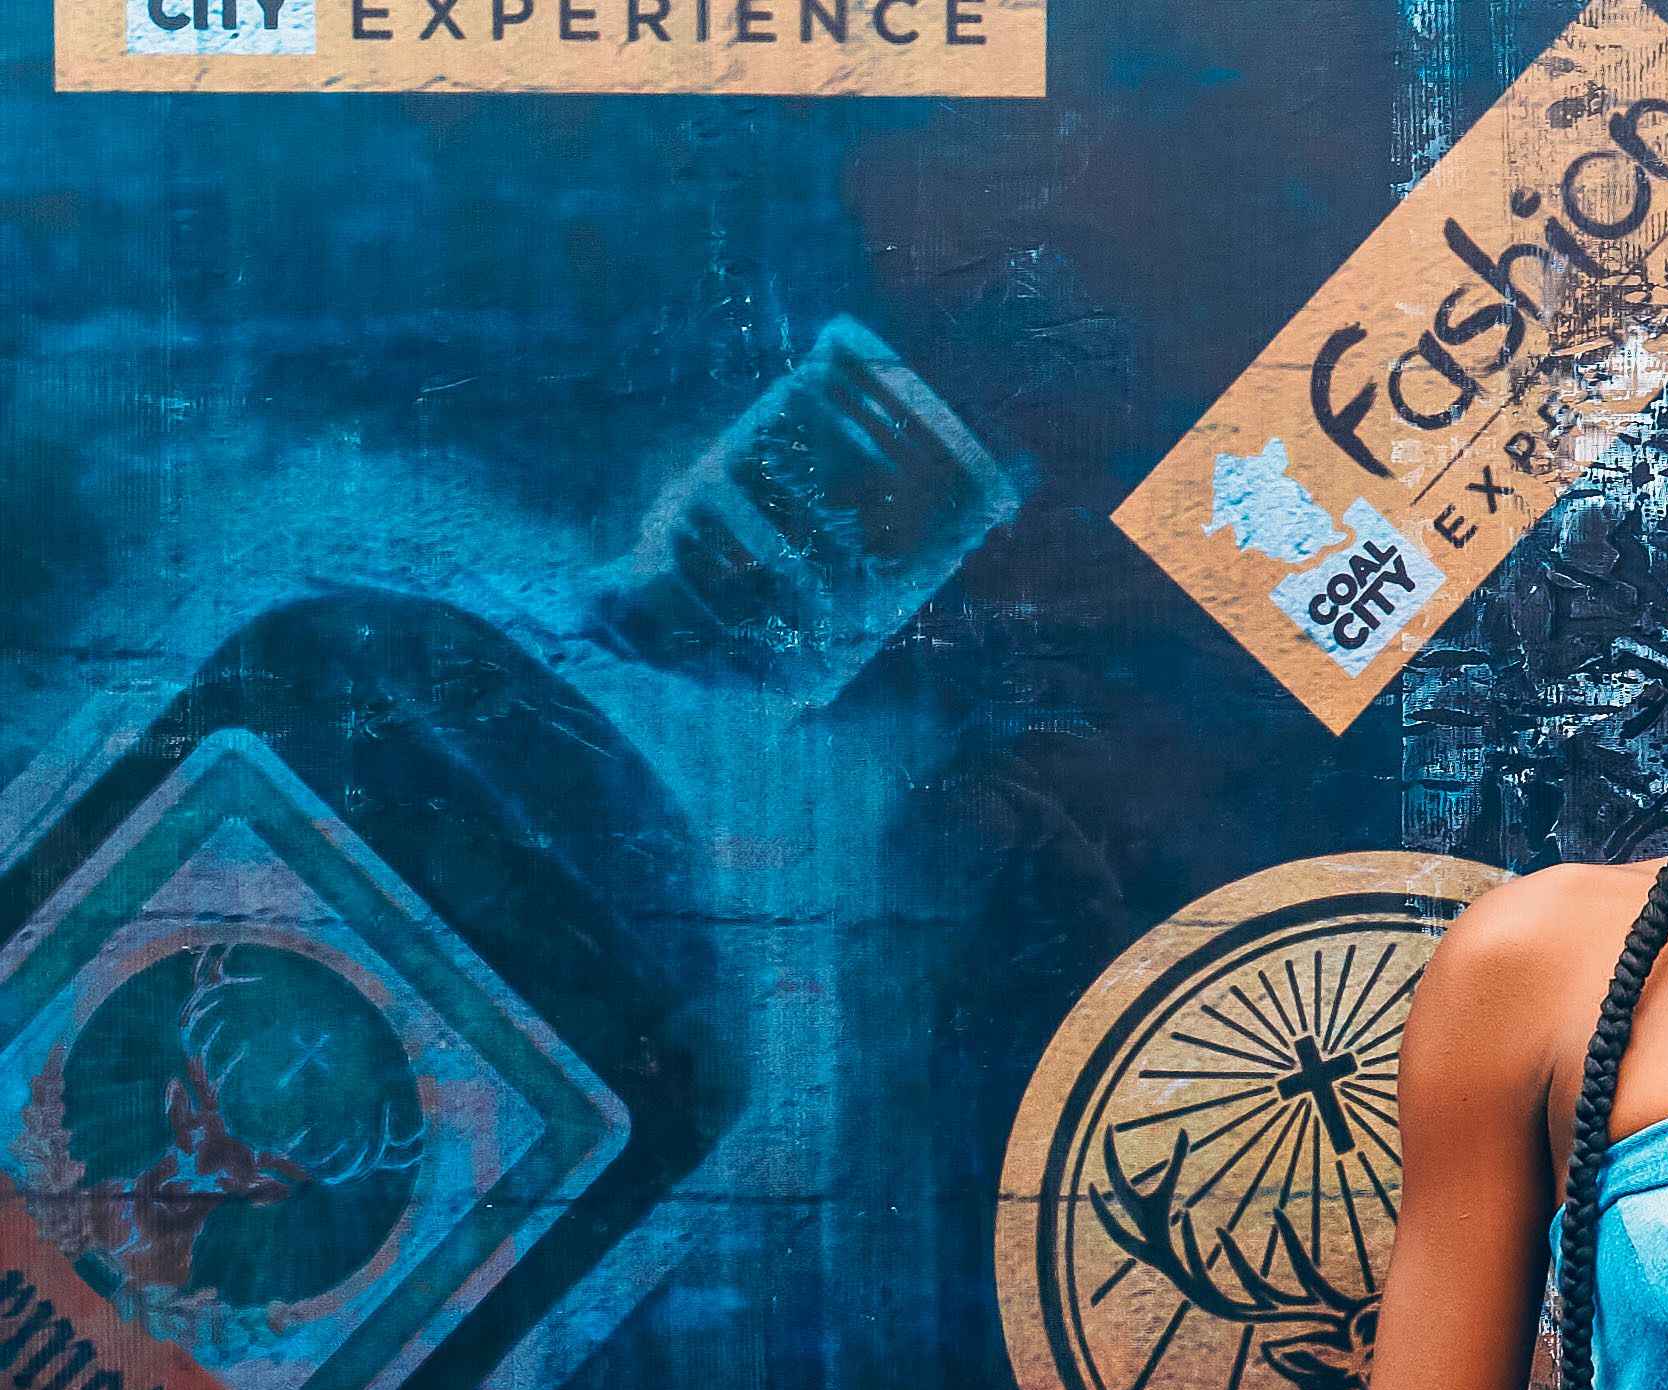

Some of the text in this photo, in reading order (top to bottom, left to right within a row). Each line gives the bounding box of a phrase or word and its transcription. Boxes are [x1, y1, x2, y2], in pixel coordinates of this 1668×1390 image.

[148, 0, 284, 30] CITY
[350, 0, 989, 44] EXPERIENCE
[1307, 538, 1398, 628] COAL
[1334, 554, 1417, 650] CITY
